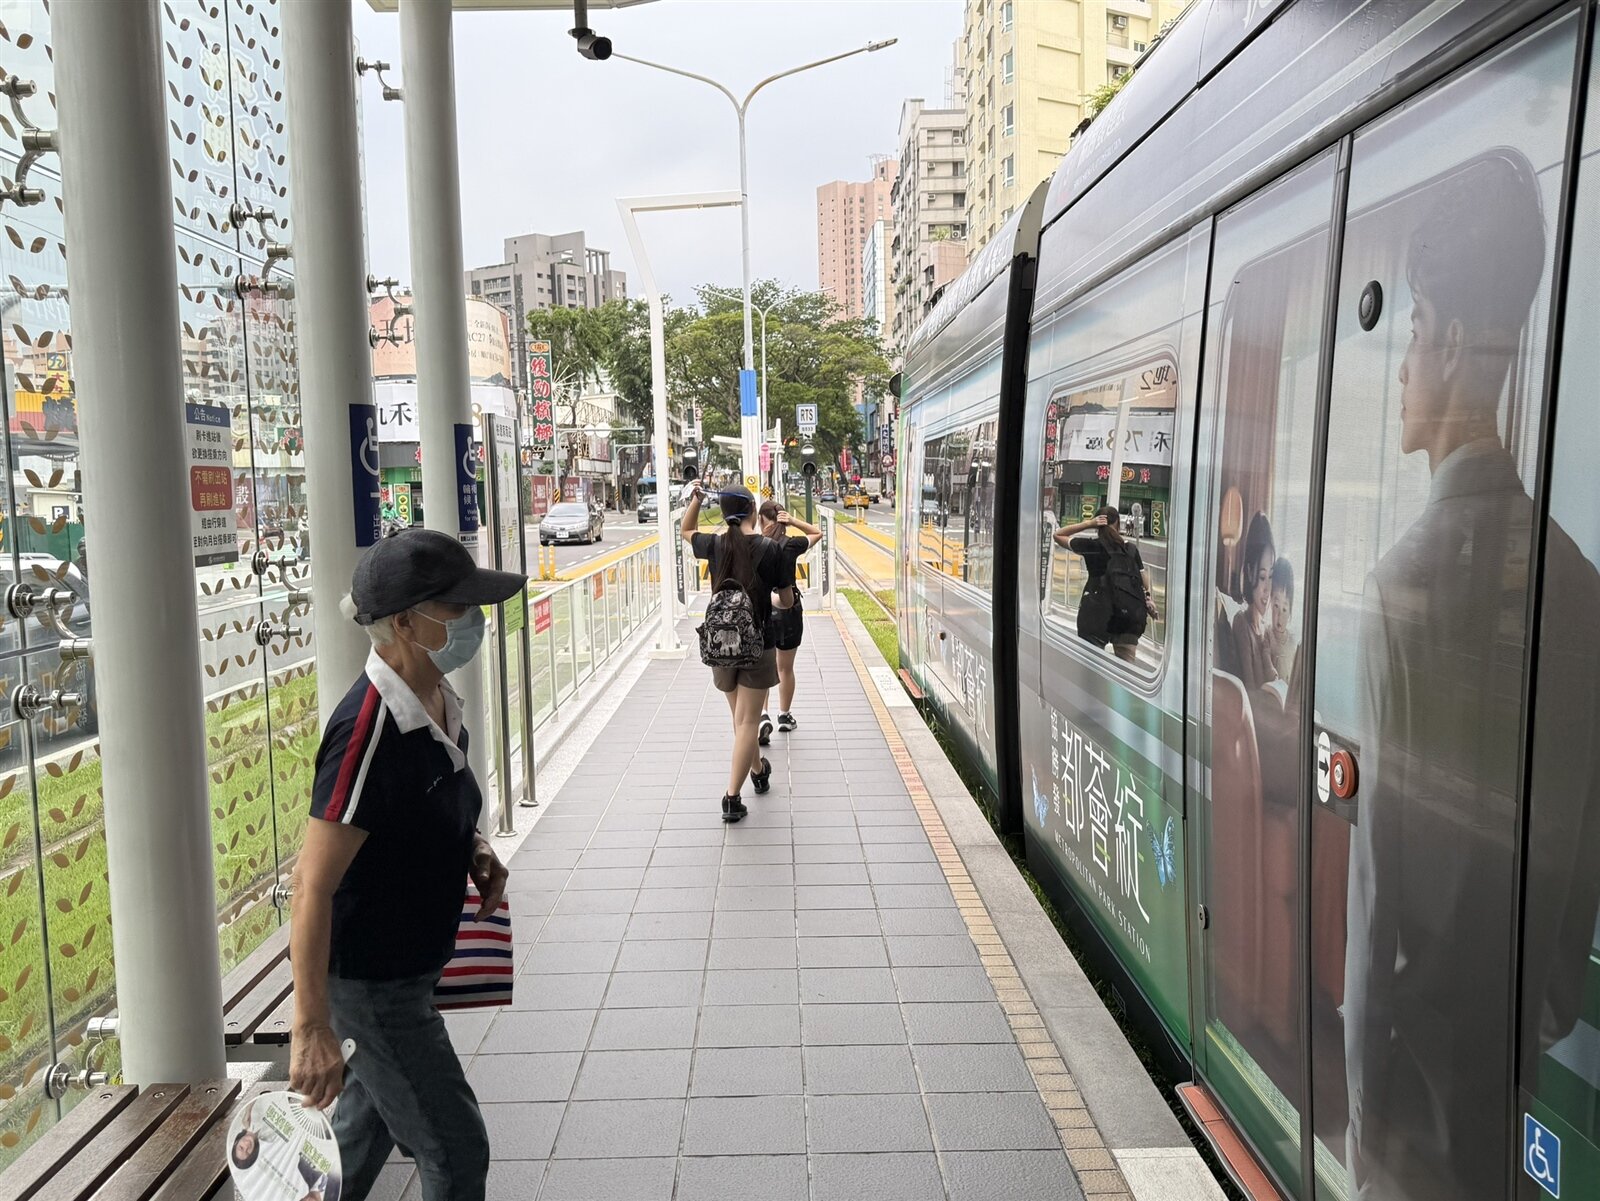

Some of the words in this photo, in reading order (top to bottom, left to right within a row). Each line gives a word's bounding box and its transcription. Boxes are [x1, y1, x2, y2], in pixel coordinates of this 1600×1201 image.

[194, 407, 205, 421] 公告
[206, 415, 220, 423] Notice
[800, 408, 813, 422] RTS
[196, 429, 221, 443] 刷卡進站後
[192, 447, 227, 461] 欲更換搭乘方向
[194, 470, 228, 485] 不需刷出站
[200, 492, 226, 507] 再刷進站
[1061, 718, 1150, 924] 都薈綻
[1054, 829, 1097, 893] METROPOLITAN
[1098, 885, 1116, 918] PARK
[1118, 910, 1151, 963] STATION
